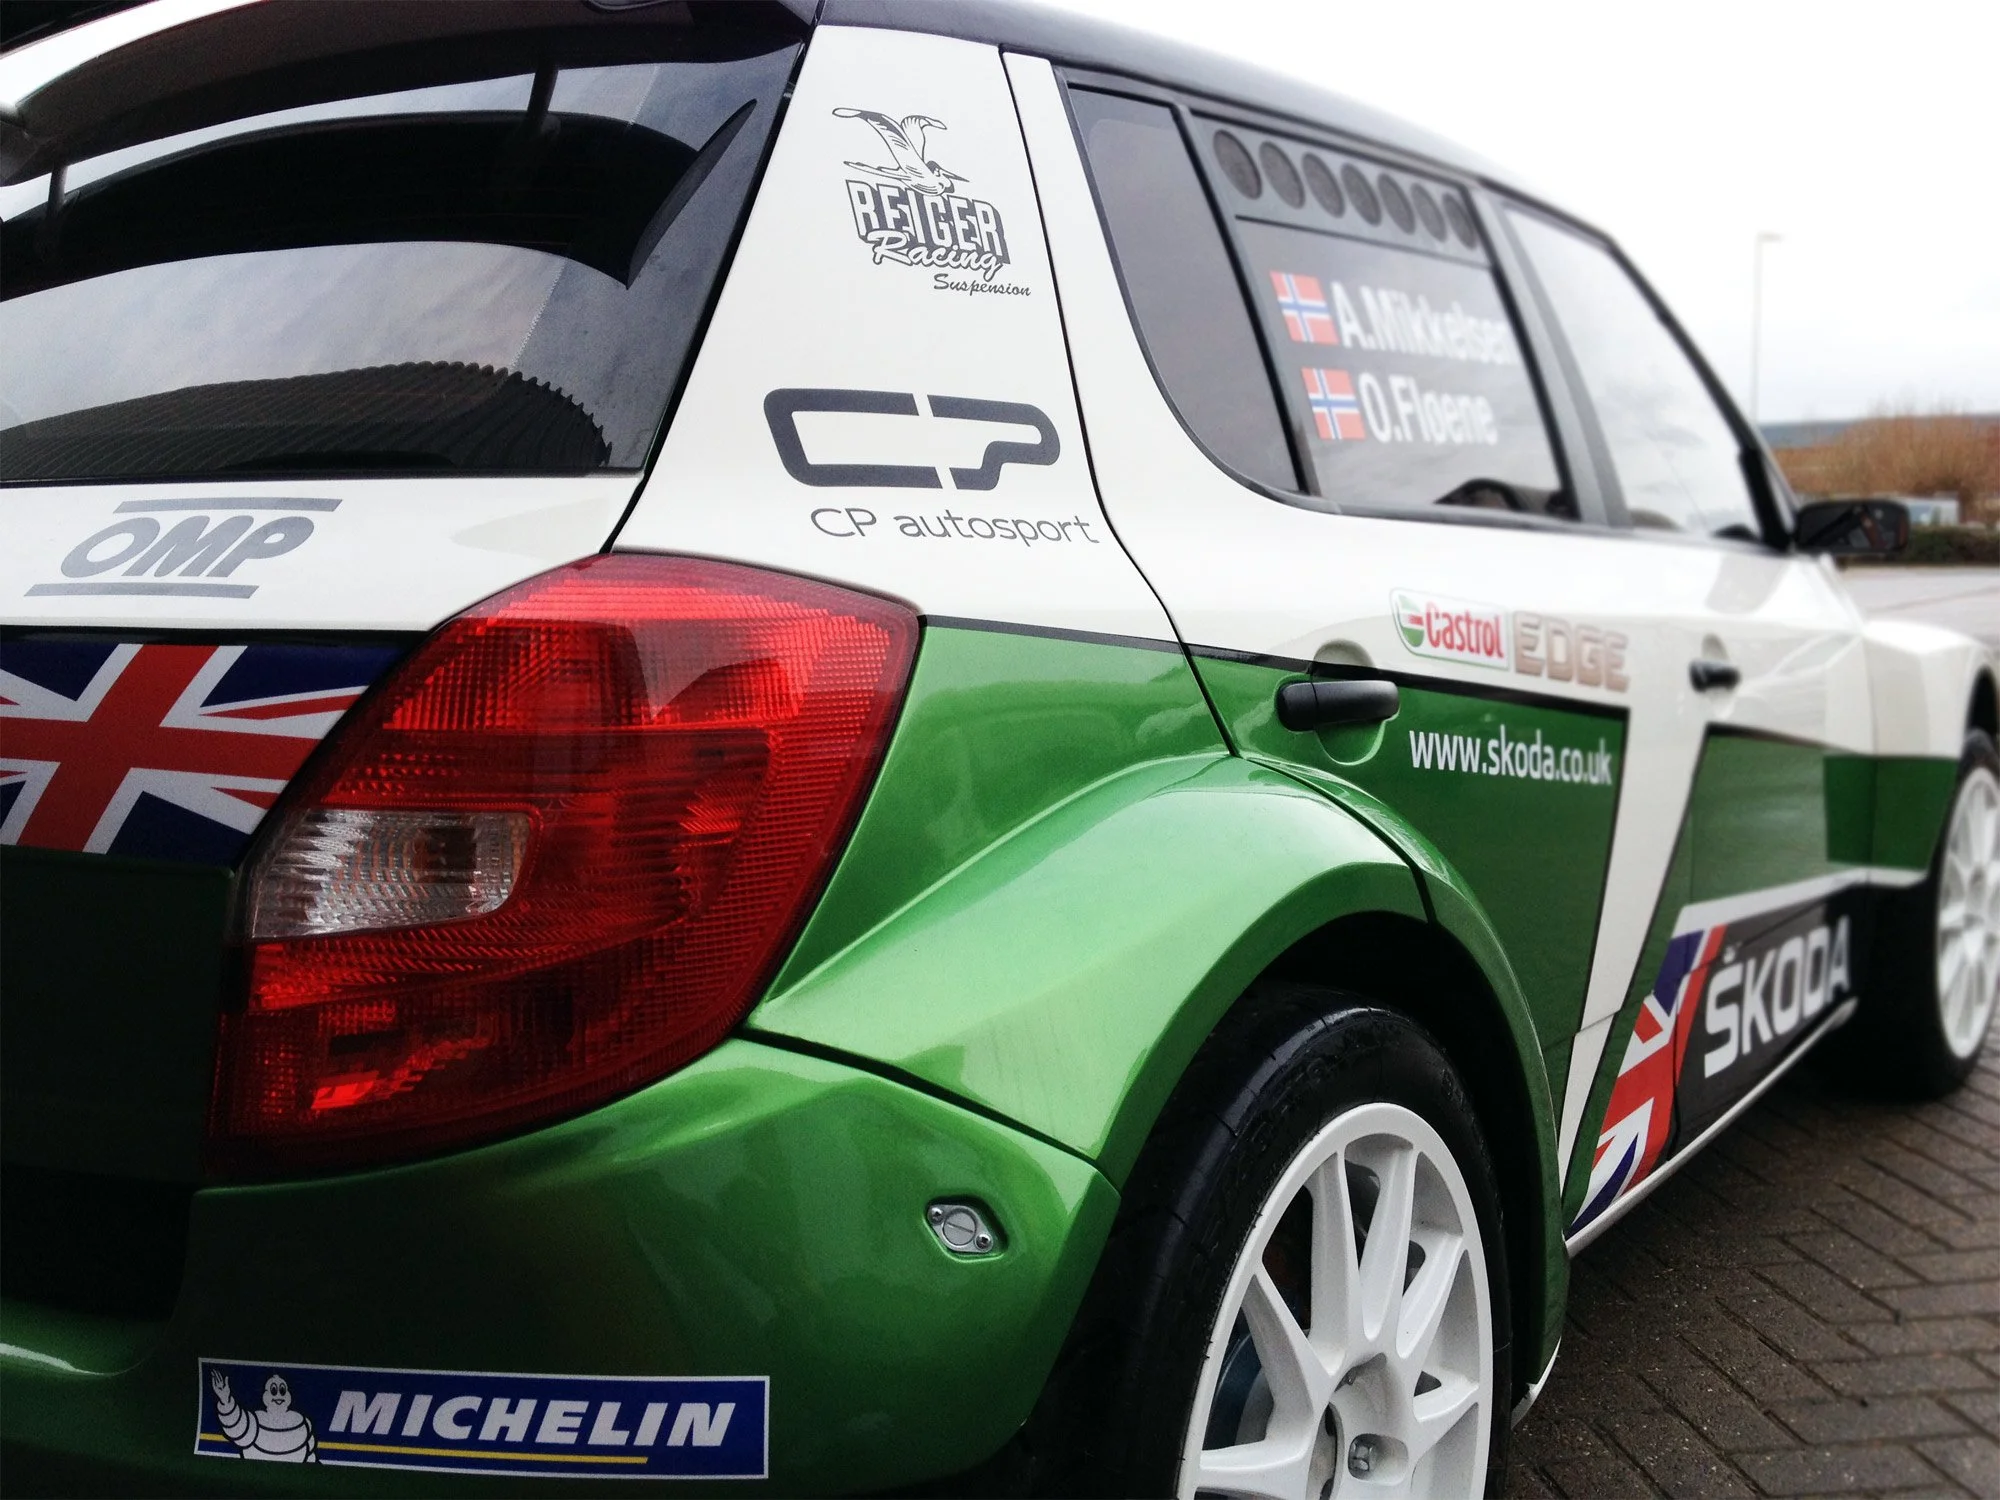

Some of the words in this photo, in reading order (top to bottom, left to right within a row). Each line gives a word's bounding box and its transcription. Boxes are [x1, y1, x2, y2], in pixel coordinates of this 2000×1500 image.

[846, 179, 1011, 264] REIGER
[867, 230, 1005, 282] Racing
[933, 273, 1032, 297] Suspension
[1358, 372, 1498, 445] O.Floene
[60, 515, 315, 578] OMP
[810, 507, 877, 538] CP
[893, 509, 1100, 547] autosport
[1424, 601, 1505, 658] Castrol
[1512, 611, 1631, 693] EDGE
[1704, 914, 1849, 1079] ŠKODA
[328, 1391, 735, 1447] MICHELIN
